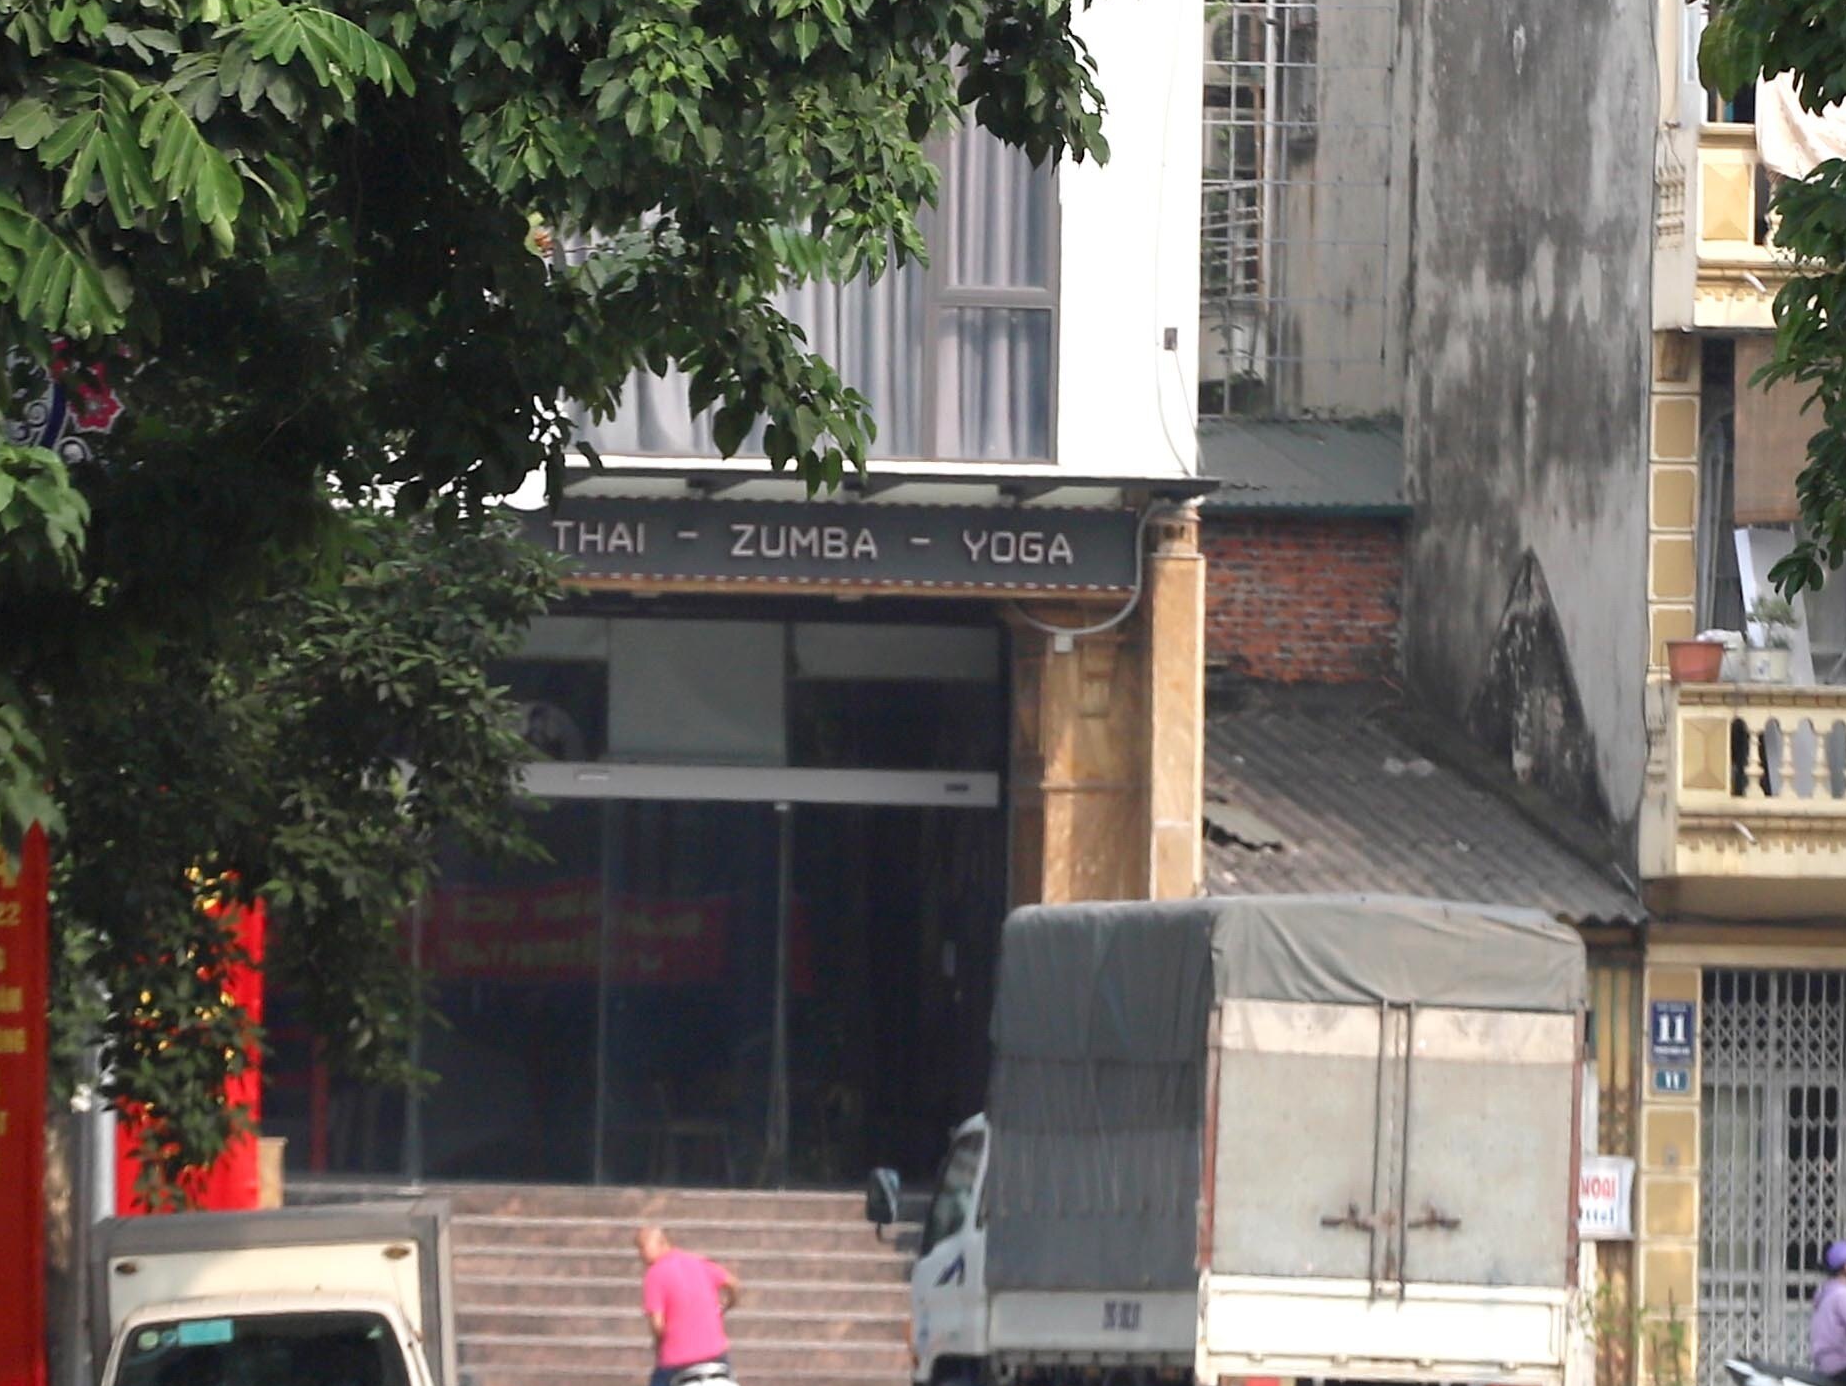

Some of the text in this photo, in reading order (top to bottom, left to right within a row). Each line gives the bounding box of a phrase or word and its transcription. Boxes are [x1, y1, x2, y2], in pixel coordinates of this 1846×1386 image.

[552, 520, 646, 553] THAI
[730, 524, 879, 560] ZUMBA
[963, 530, 1074, 564] YOGA
[1658, 1015, 1687, 1043] 11
